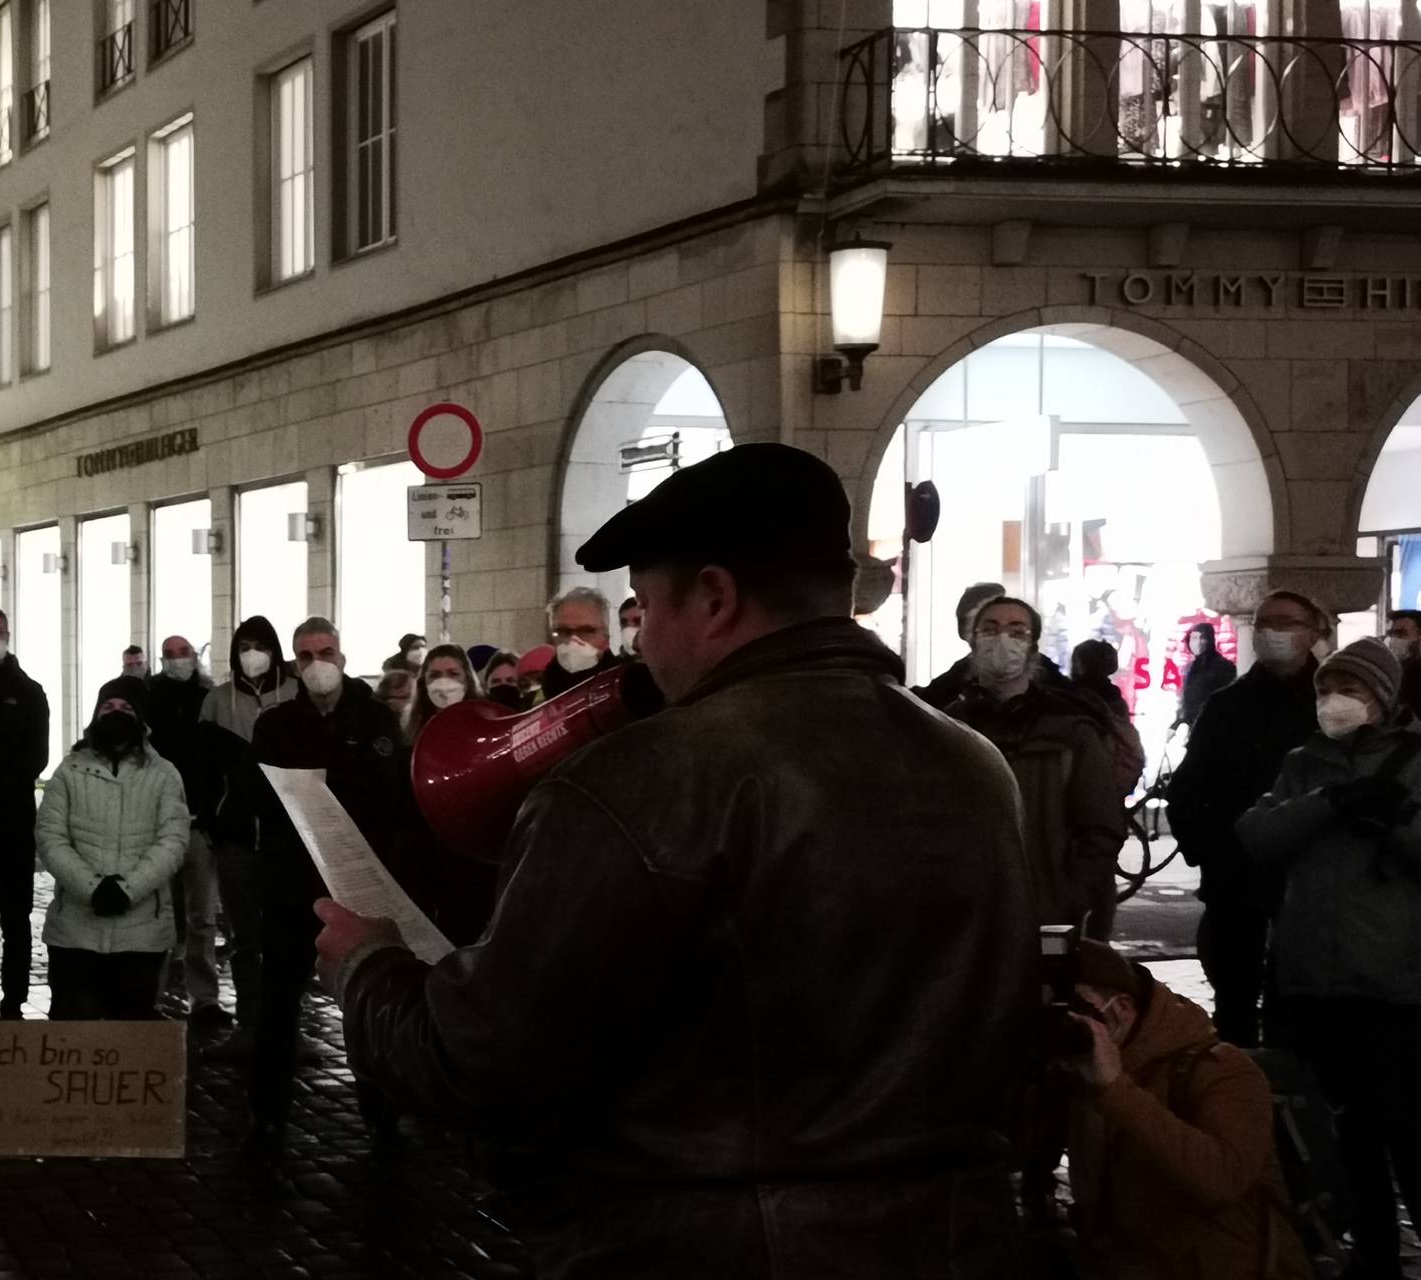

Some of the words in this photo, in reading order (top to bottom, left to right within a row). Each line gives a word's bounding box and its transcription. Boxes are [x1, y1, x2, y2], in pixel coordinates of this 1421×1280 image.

[1081, 272, 1286, 307] TOMMY
[1363, 278, 1421, 309] HI
[76, 446, 125, 477] TOMMY
[1135, 658, 1182, 690] SA
[40, 1033, 82, 1066] bin
[92, 1048, 120, 1066] so
